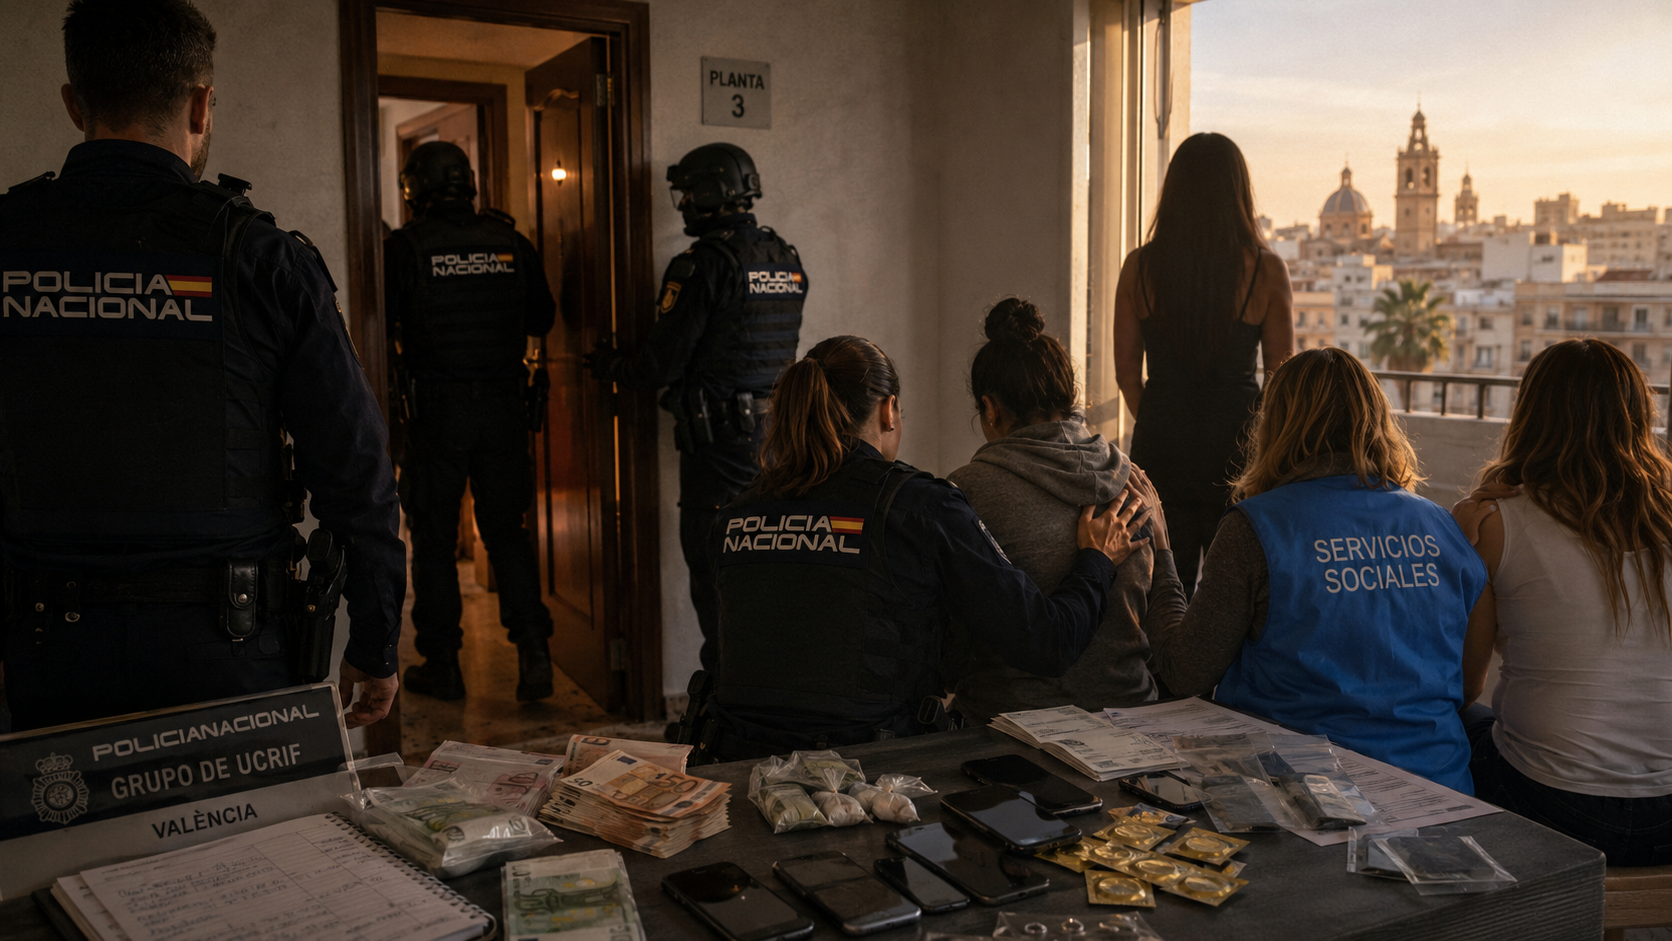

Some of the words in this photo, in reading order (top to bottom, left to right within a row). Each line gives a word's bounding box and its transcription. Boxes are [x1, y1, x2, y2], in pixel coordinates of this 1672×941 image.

[709, 70, 765, 90] PLANTA
[731, 93, 745, 118] 3
[431, 252, 499, 266] POLICIA
[432, 262, 515, 277] NACIONAL
[3, 270, 173, 296] POLICIA
[748, 270, 794, 283] POLICIA
[749, 282, 803, 294] NACIONAL
[3, 295, 213, 322] NACIONAL
[725, 515, 832, 535] POLICIA
[723, 533, 860, 554] NACIONAL
[1314, 534, 1441, 563] SERVICIOS
[1324, 562, 1440, 594] SOCIALES
[111, 764, 194, 800] GRUPO
[199, 757, 231, 783] DE
[236, 743, 301, 775] UCRIF
[152, 803, 258, 839] VALÈNCIA
